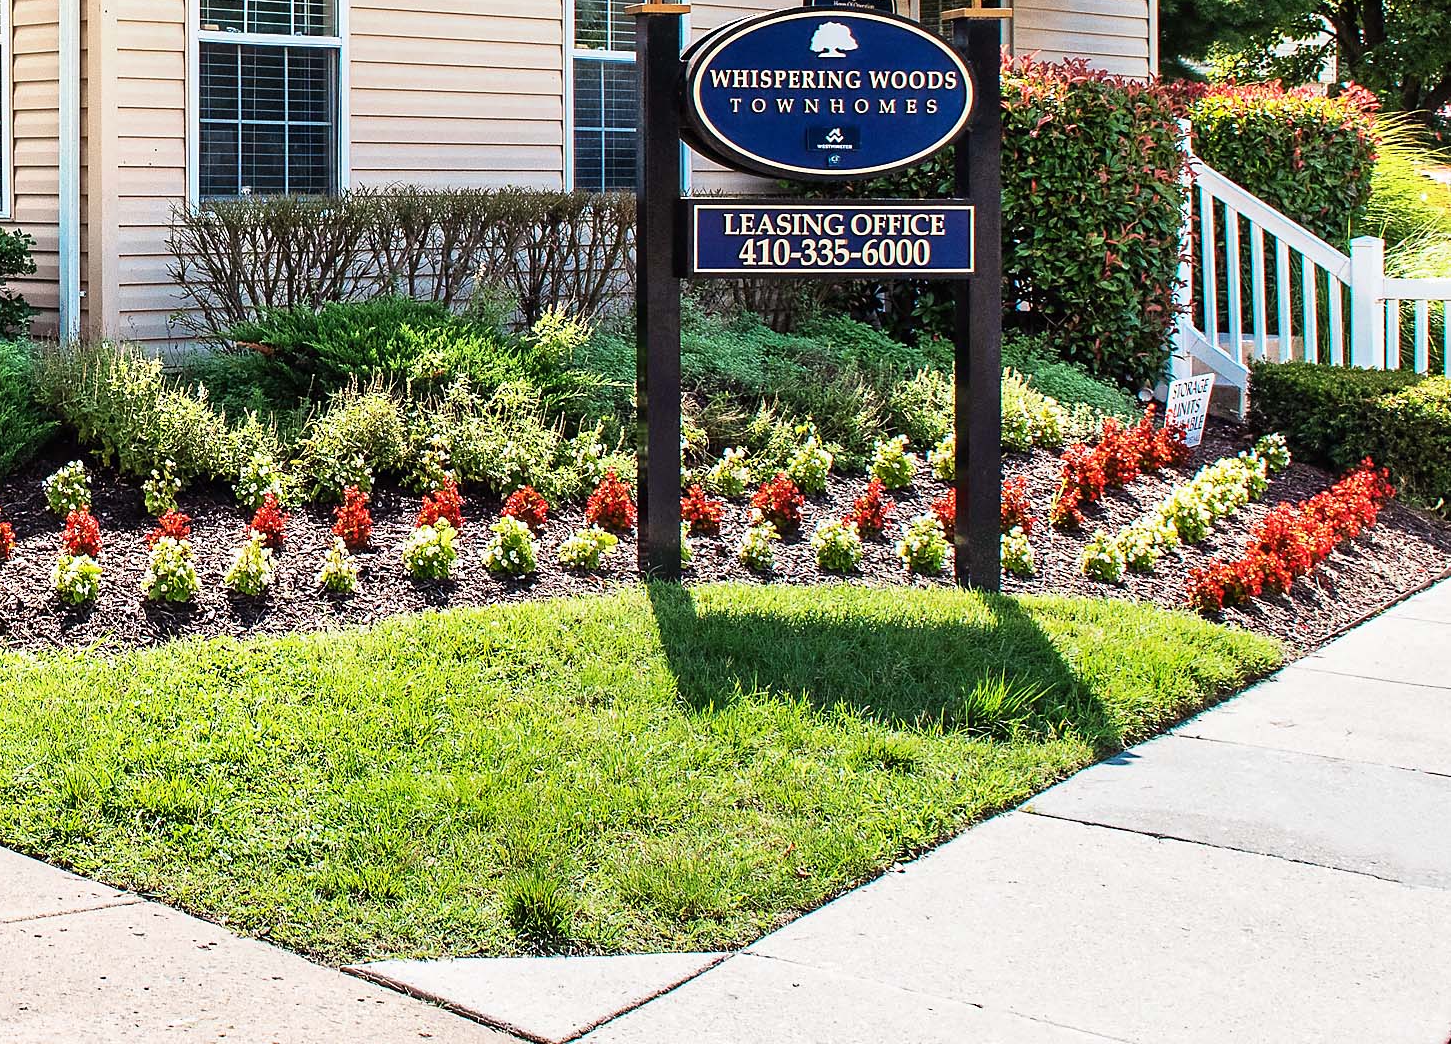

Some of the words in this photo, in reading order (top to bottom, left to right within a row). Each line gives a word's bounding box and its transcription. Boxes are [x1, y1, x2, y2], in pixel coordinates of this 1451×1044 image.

[710, 69, 862, 90] WHISPERING
[868, 70, 957, 90] WOODS
[729, 98, 939, 114] TOWNHOMES
[723, 213, 845, 236] LEASING
[850, 213, 946, 236] OFFICE
[738, 238, 931, 266] 410-335-6000
[1172, 378, 1209, 400] STORAGE
[1173, 398, 1202, 417] UNITS
